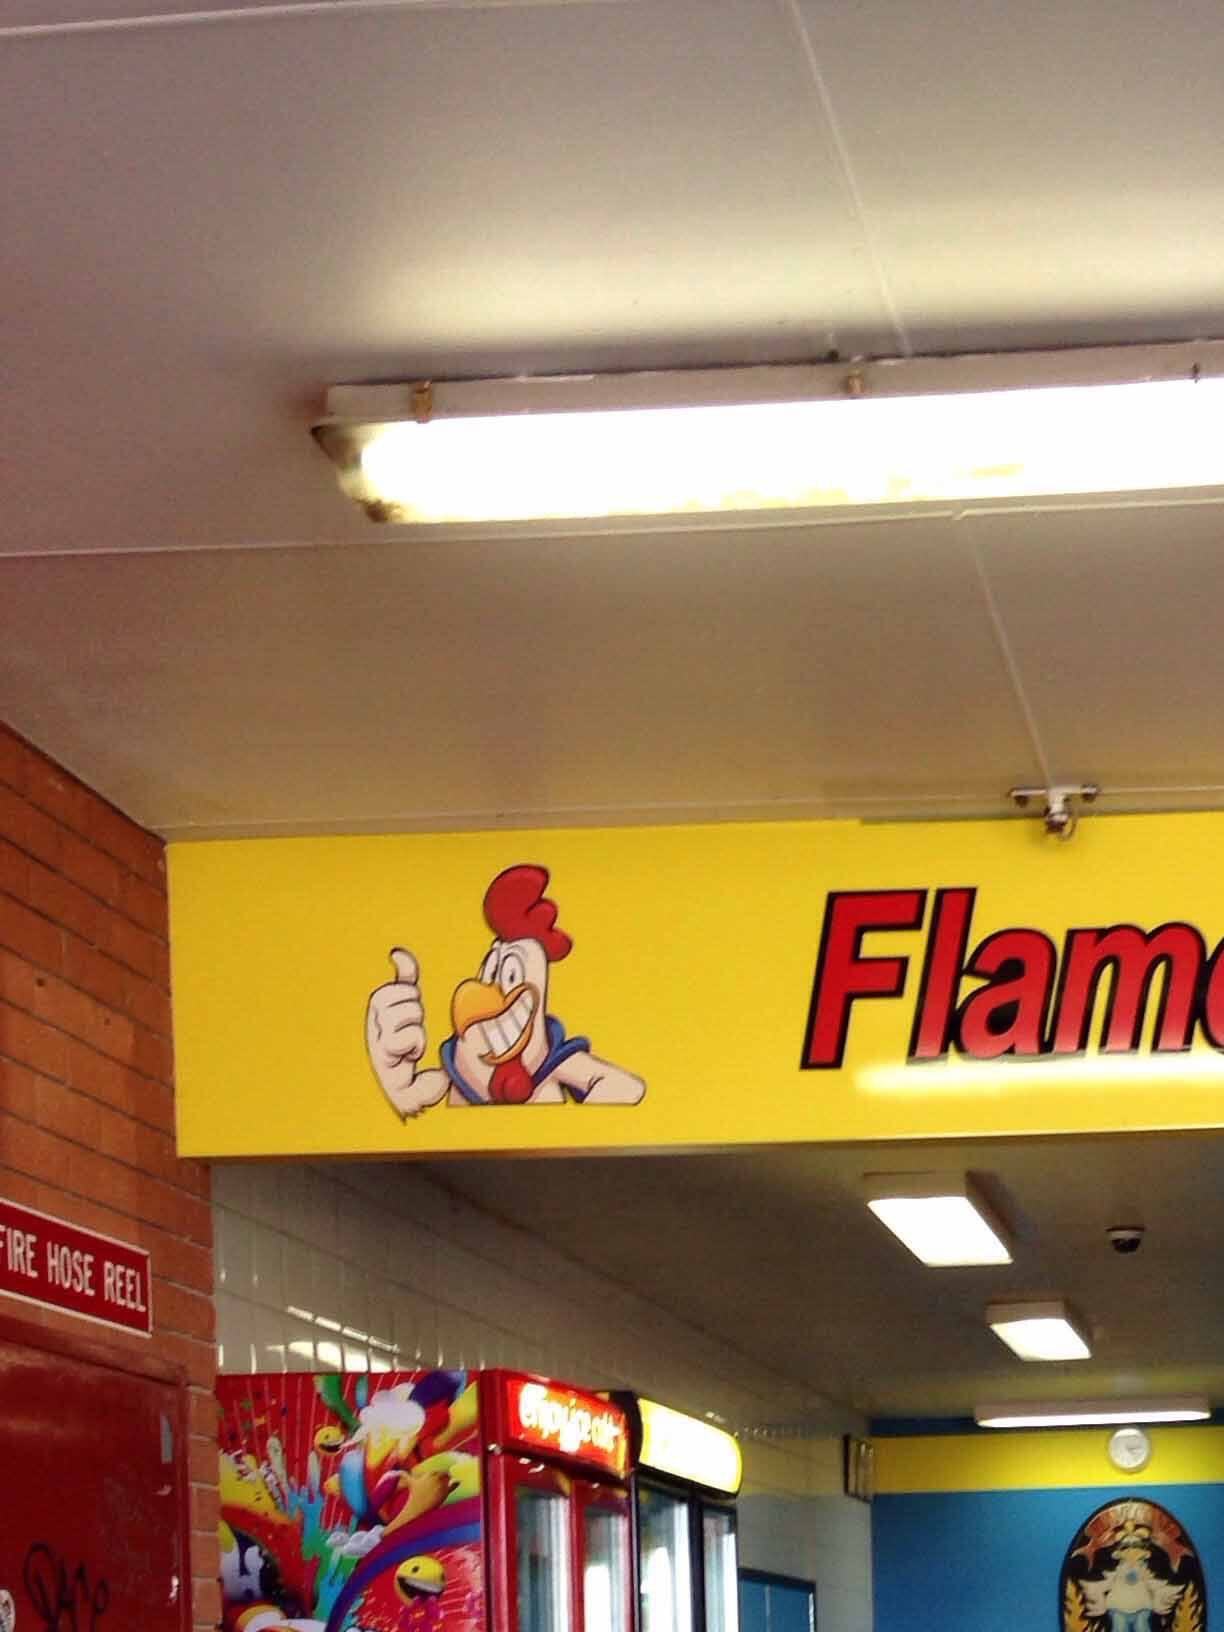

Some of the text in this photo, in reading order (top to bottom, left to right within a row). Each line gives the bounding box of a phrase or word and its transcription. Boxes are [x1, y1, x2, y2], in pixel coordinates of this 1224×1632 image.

[0, 1224, 146, 1312] FIRE HOSE REEL
